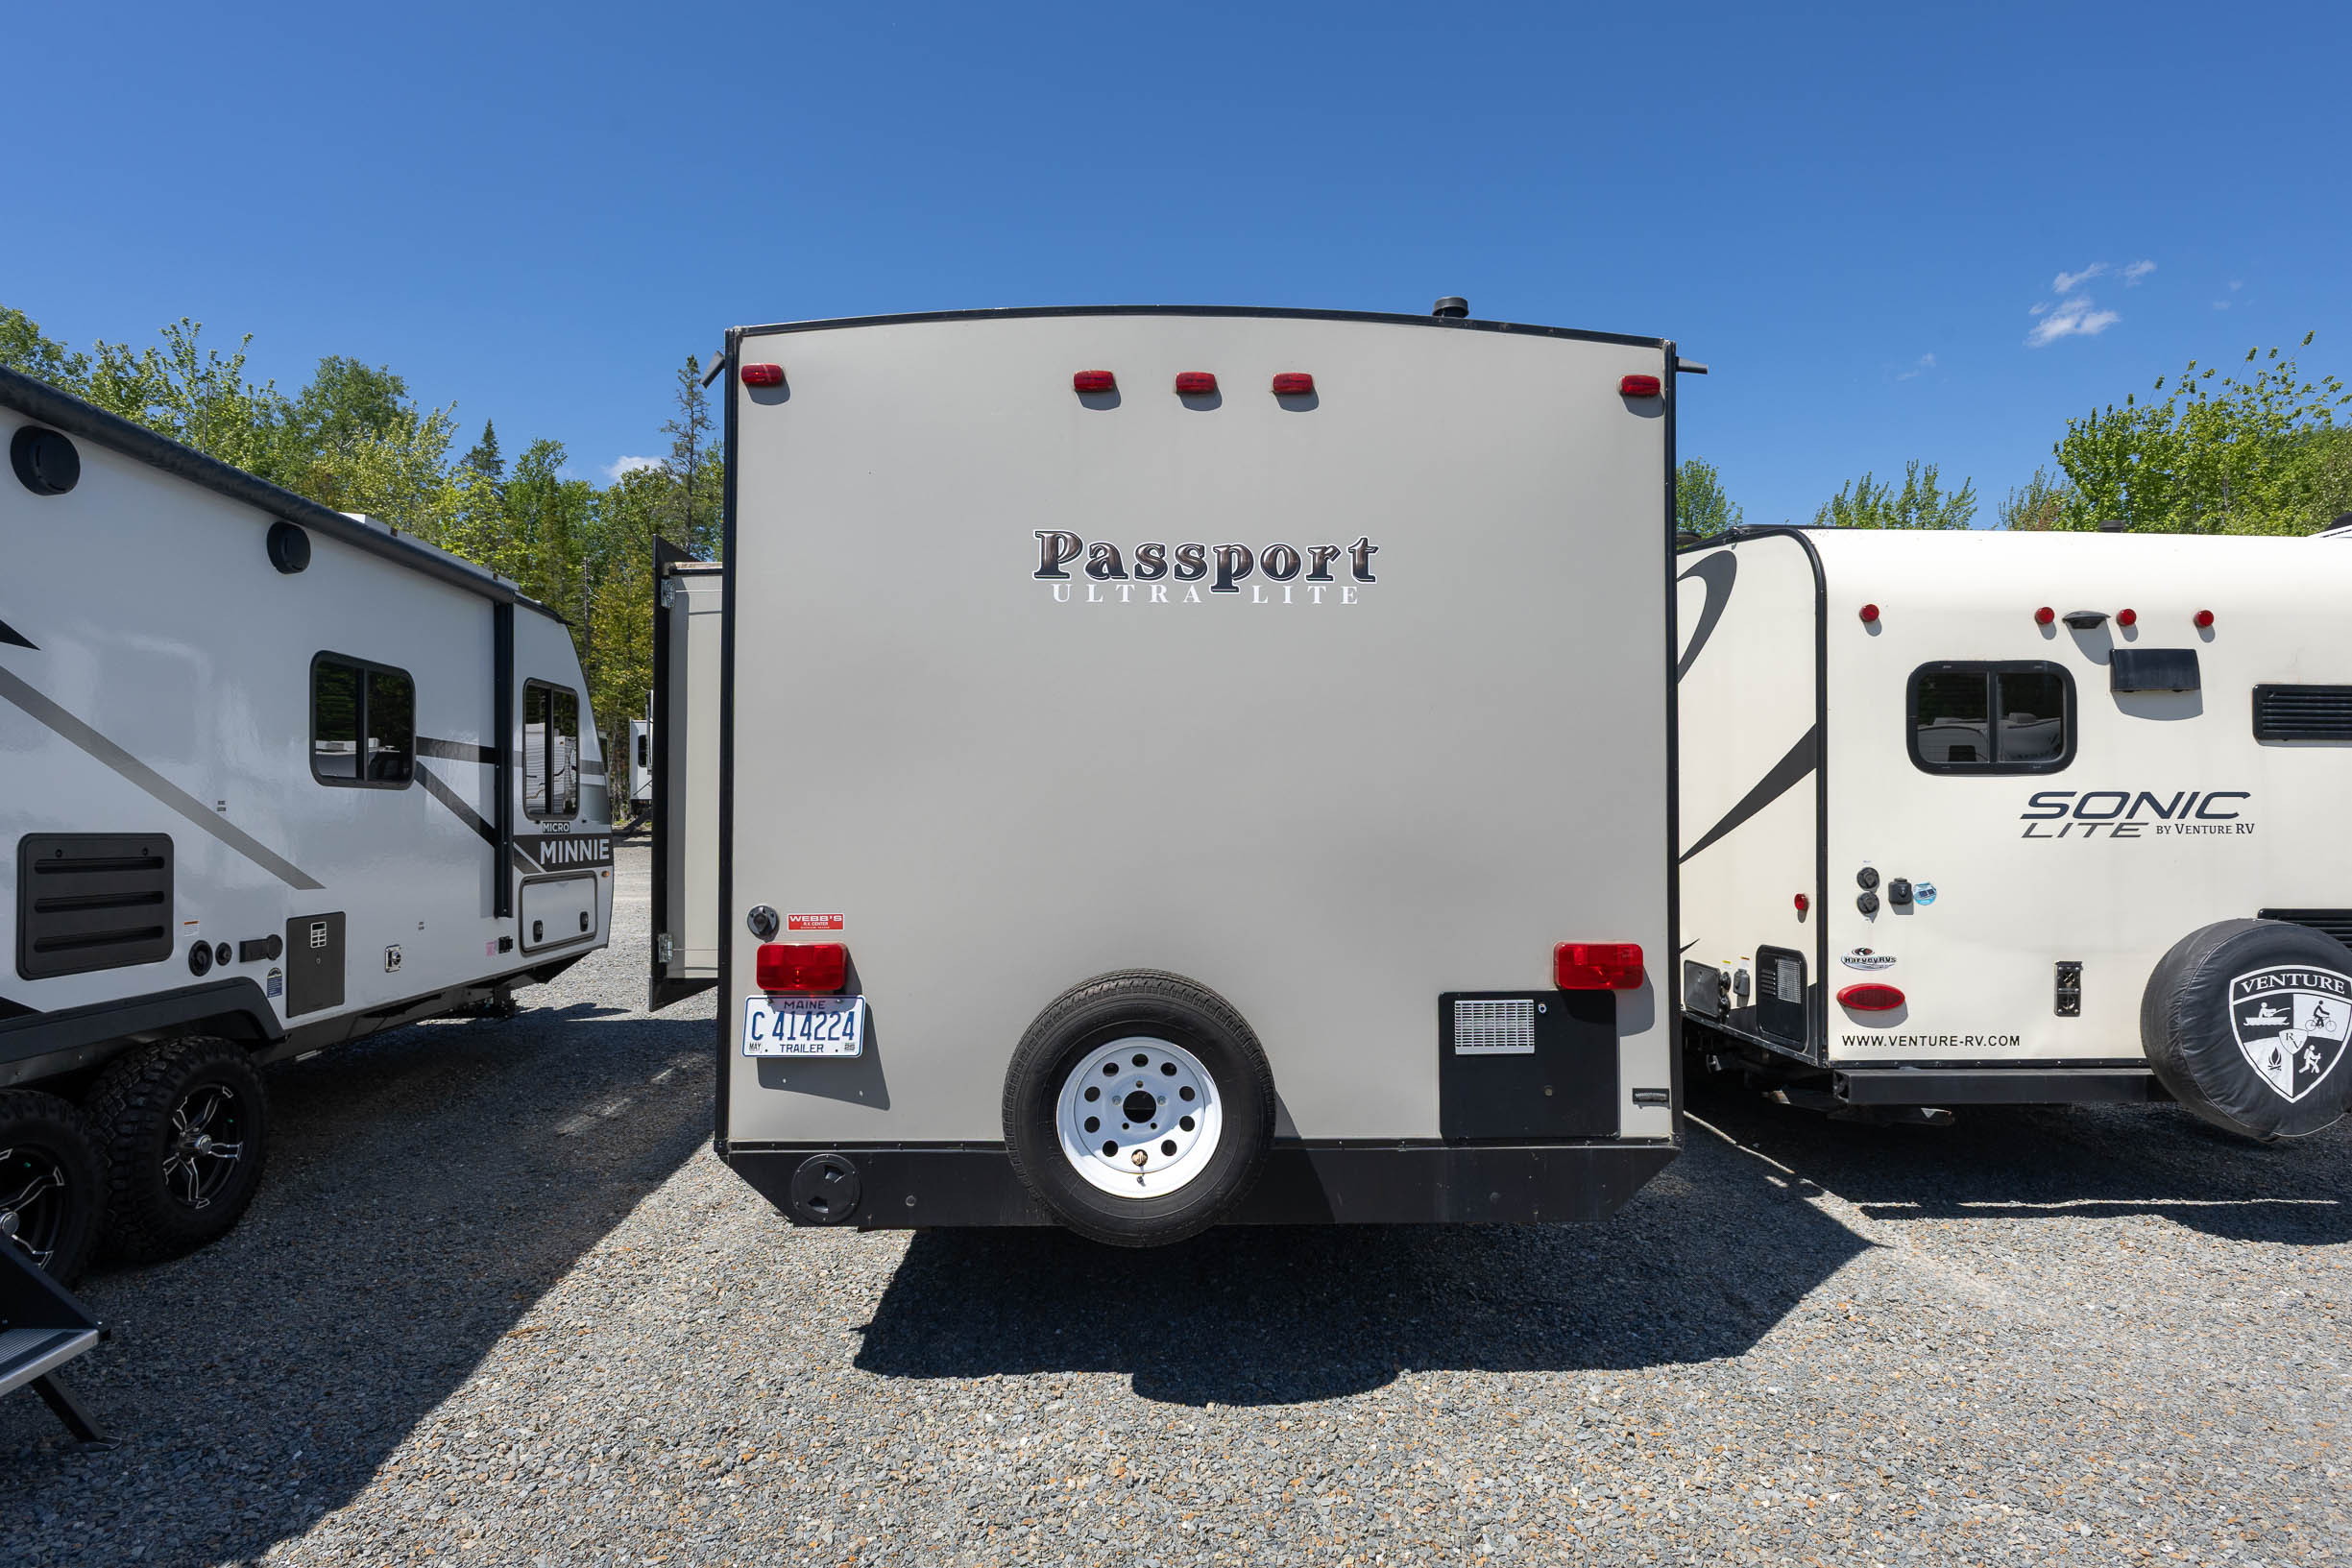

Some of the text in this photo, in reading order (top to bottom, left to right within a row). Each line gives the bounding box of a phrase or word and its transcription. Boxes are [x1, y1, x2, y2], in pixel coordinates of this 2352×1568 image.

[1032, 529, 1379, 593] Passport
[1053, 584, 1358, 605] ULTRA LITE
[2020, 791, 2251, 820] SONIC
[543, 822, 570, 832] MICRO
[2021, 822, 2150, 838] LITE
[2235, 823, 2256, 834] RV
[540, 838, 610, 865] MINNIE
[2241, 973, 2345, 995] VENTURE
[784, 1001, 826, 1009] MAINE
[780, 1044, 824, 1053] TRAILER
[1841, 1035, 2021, 1047] WWW.VENTURE-RV.COM
